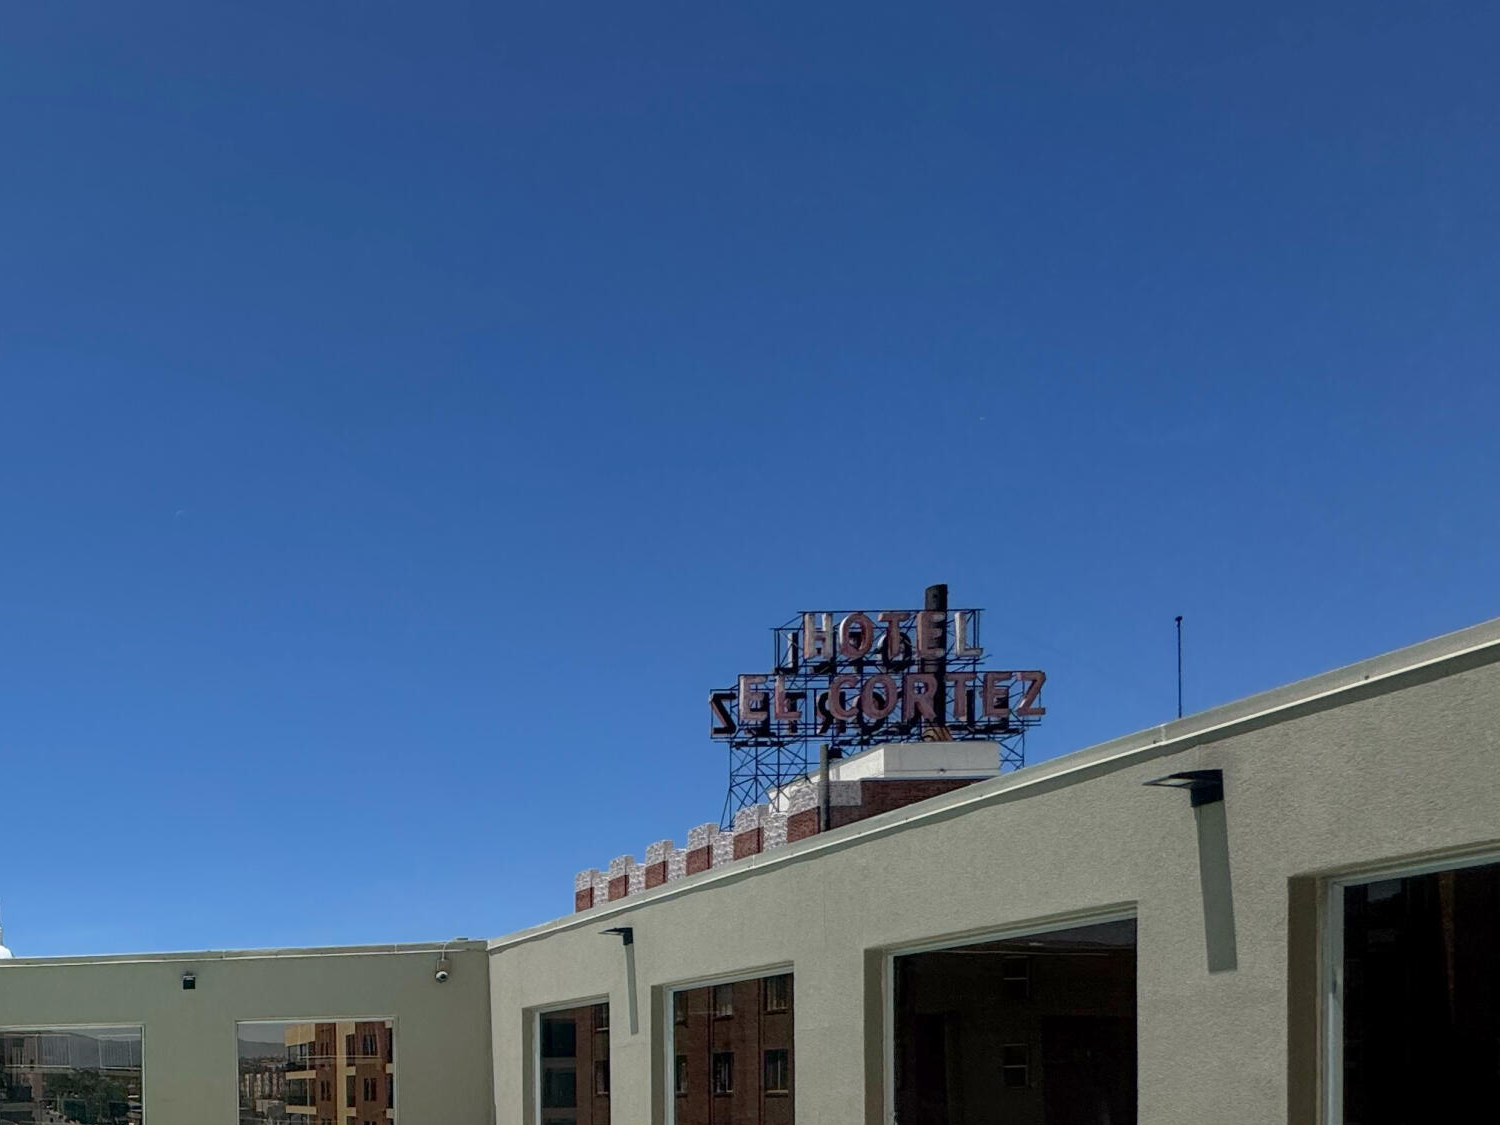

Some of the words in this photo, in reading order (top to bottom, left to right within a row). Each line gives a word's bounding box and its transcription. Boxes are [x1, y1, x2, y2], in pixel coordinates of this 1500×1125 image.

[804, 611, 984, 660] HOTEL
[739, 674, 802, 722] EL
[829, 671, 1047, 721] CORTEZ
